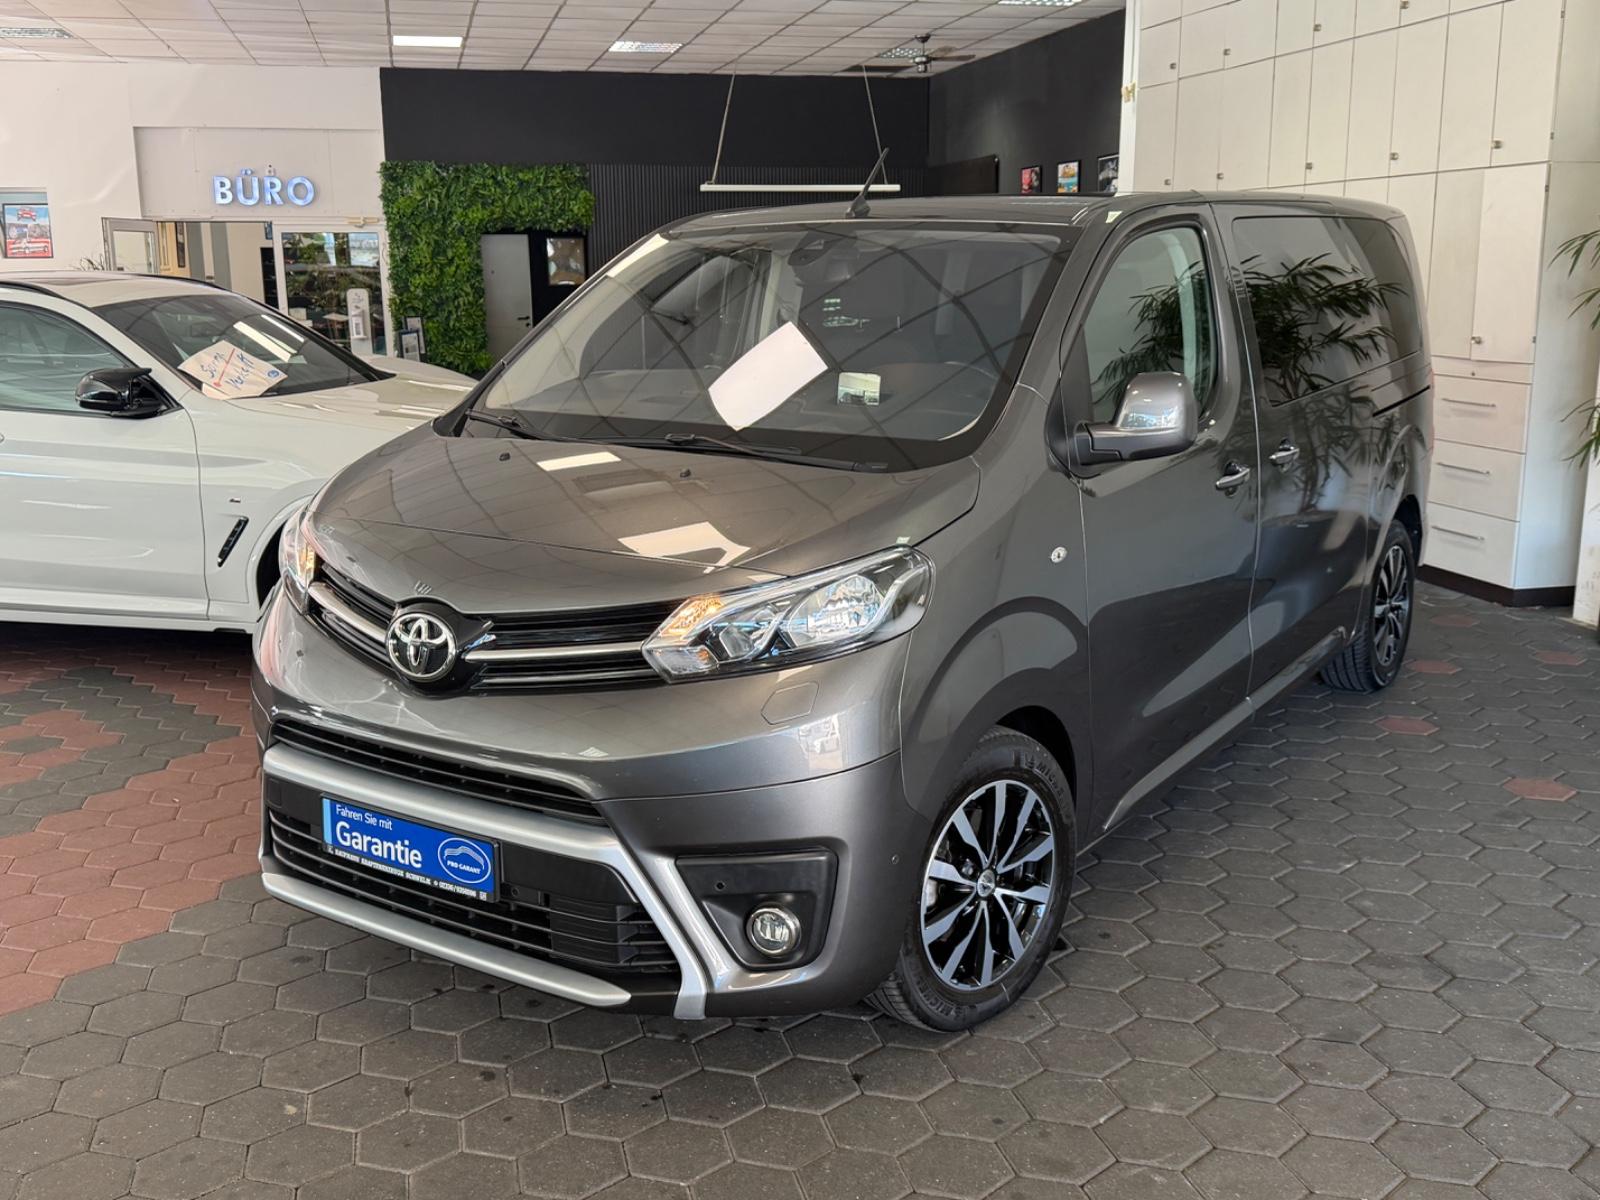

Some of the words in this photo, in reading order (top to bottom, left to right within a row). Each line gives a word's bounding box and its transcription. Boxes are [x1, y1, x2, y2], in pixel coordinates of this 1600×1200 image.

[212, 168, 315, 206] BÜRO
[335, 804, 363, 822] Fahren
[364, 812, 378, 827] Sie
[378, 818, 393, 831] mit
[335, 820, 423, 869] Garantie
